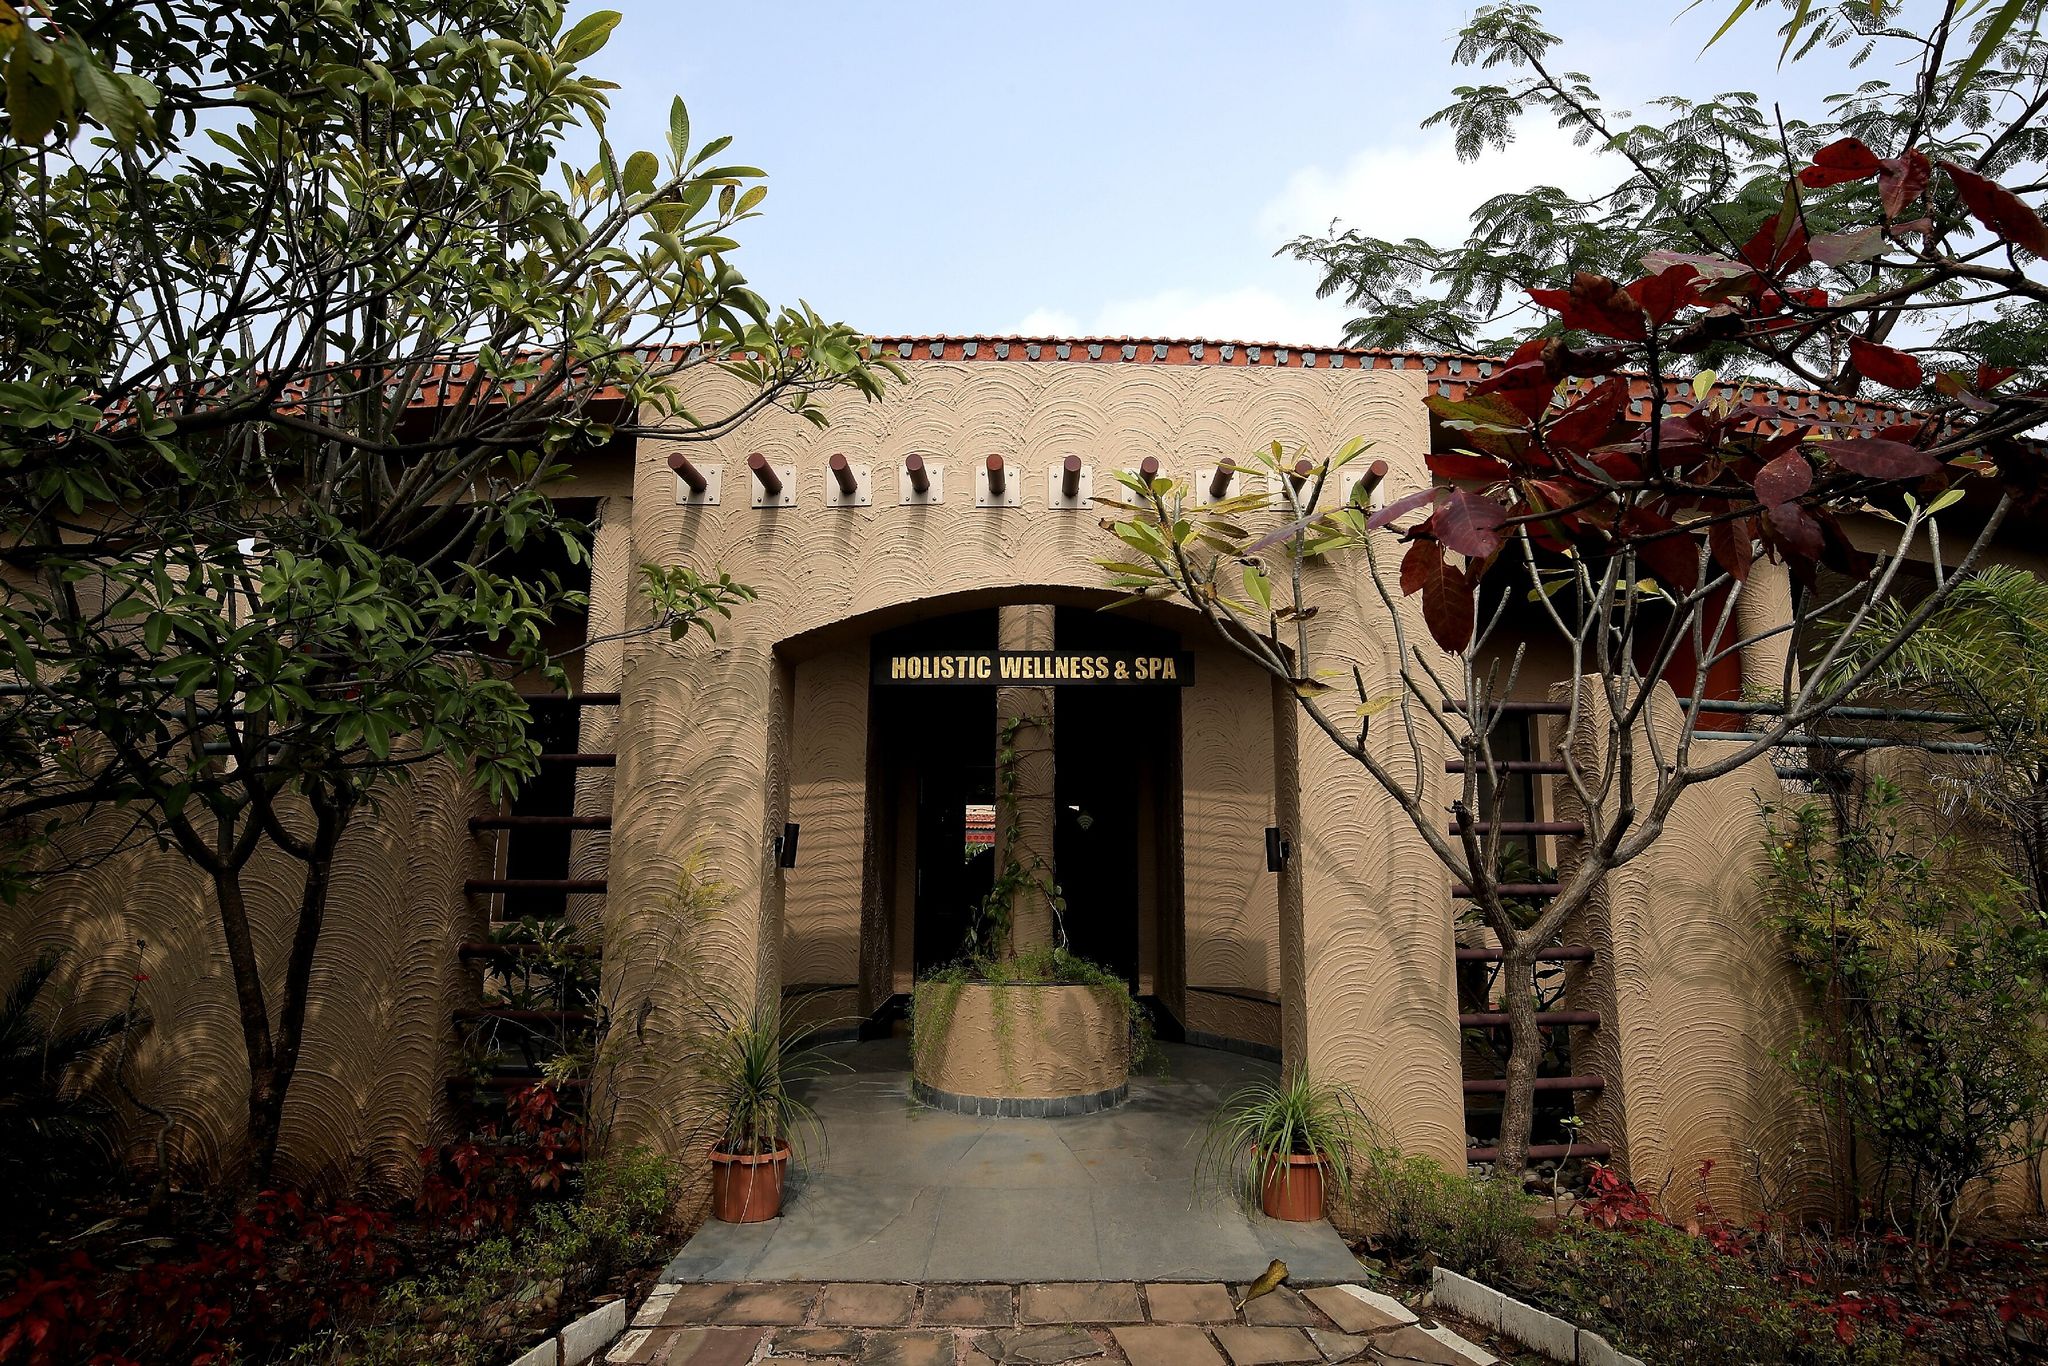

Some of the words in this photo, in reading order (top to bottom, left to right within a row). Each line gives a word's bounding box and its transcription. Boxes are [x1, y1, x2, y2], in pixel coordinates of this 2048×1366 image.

[891, 656, 991, 679] HOLISTIC
[999, 656, 1109, 679] WELLNESS
[1113, 660, 1130, 679] &
[1135, 656, 1177, 679] SPA
